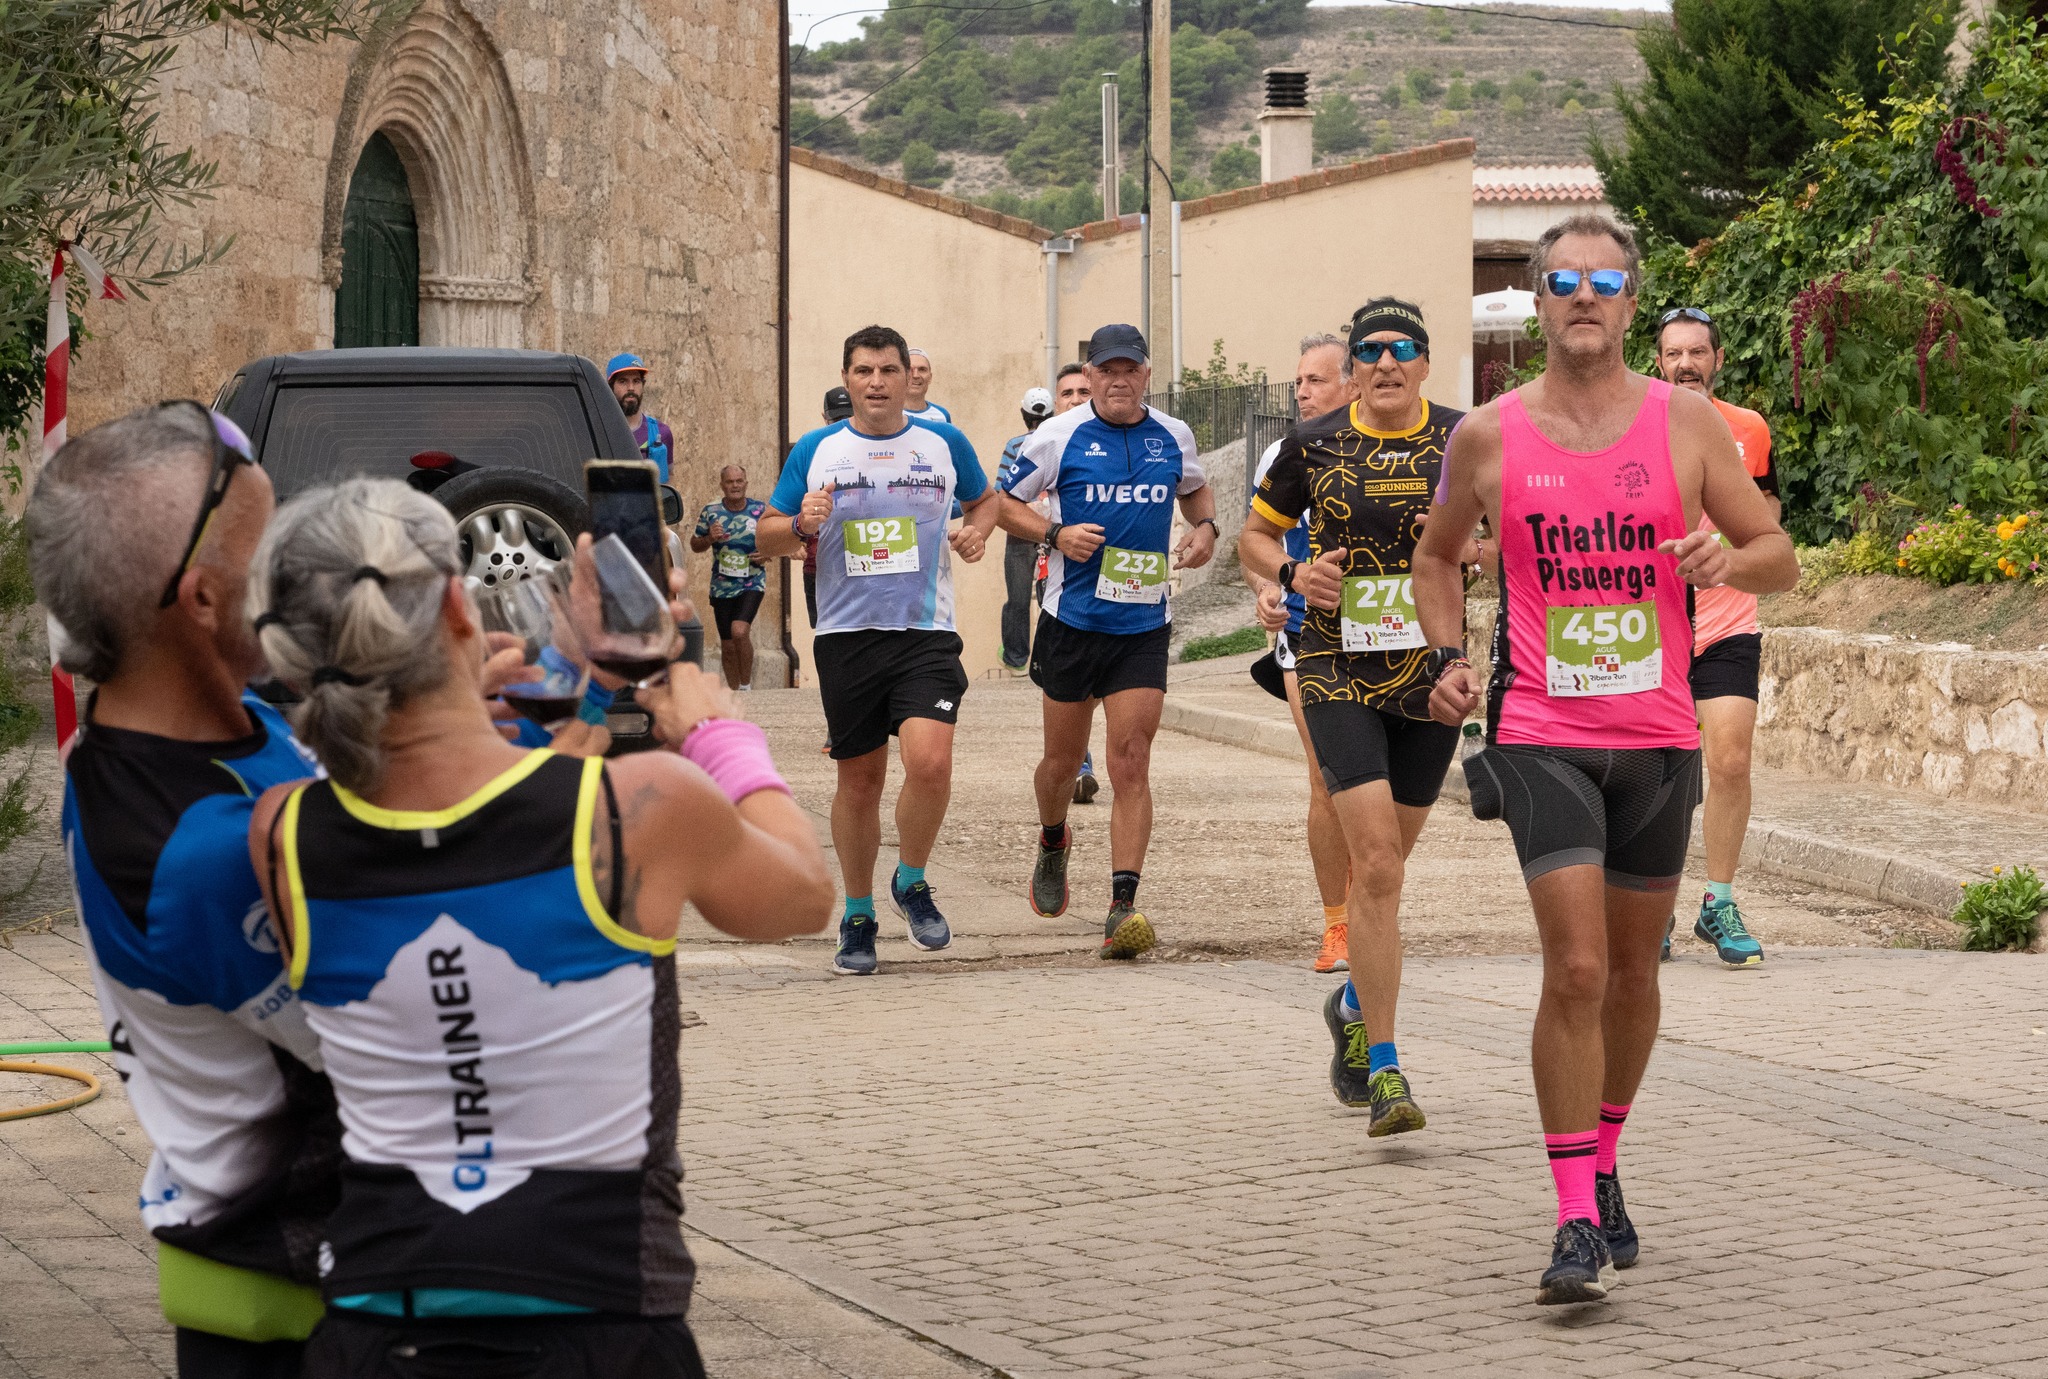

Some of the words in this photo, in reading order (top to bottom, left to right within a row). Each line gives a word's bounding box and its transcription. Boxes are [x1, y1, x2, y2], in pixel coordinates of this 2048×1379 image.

[1380, 481, 1428, 491] RUNNERS
[1527, 474, 1565, 487] GOBIK
[1085, 484, 1168, 503] IVECO
[855, 520, 902, 543] 192
[1525, 511, 1655, 554] Triatlón
[724, 555, 745, 565] 423
[1114, 552, 1158, 575] 232
[1536, 557, 1656, 599] Pisuerga
[1562, 609, 1647, 645] 450
[1589, 674, 1611, 682] Ribera
